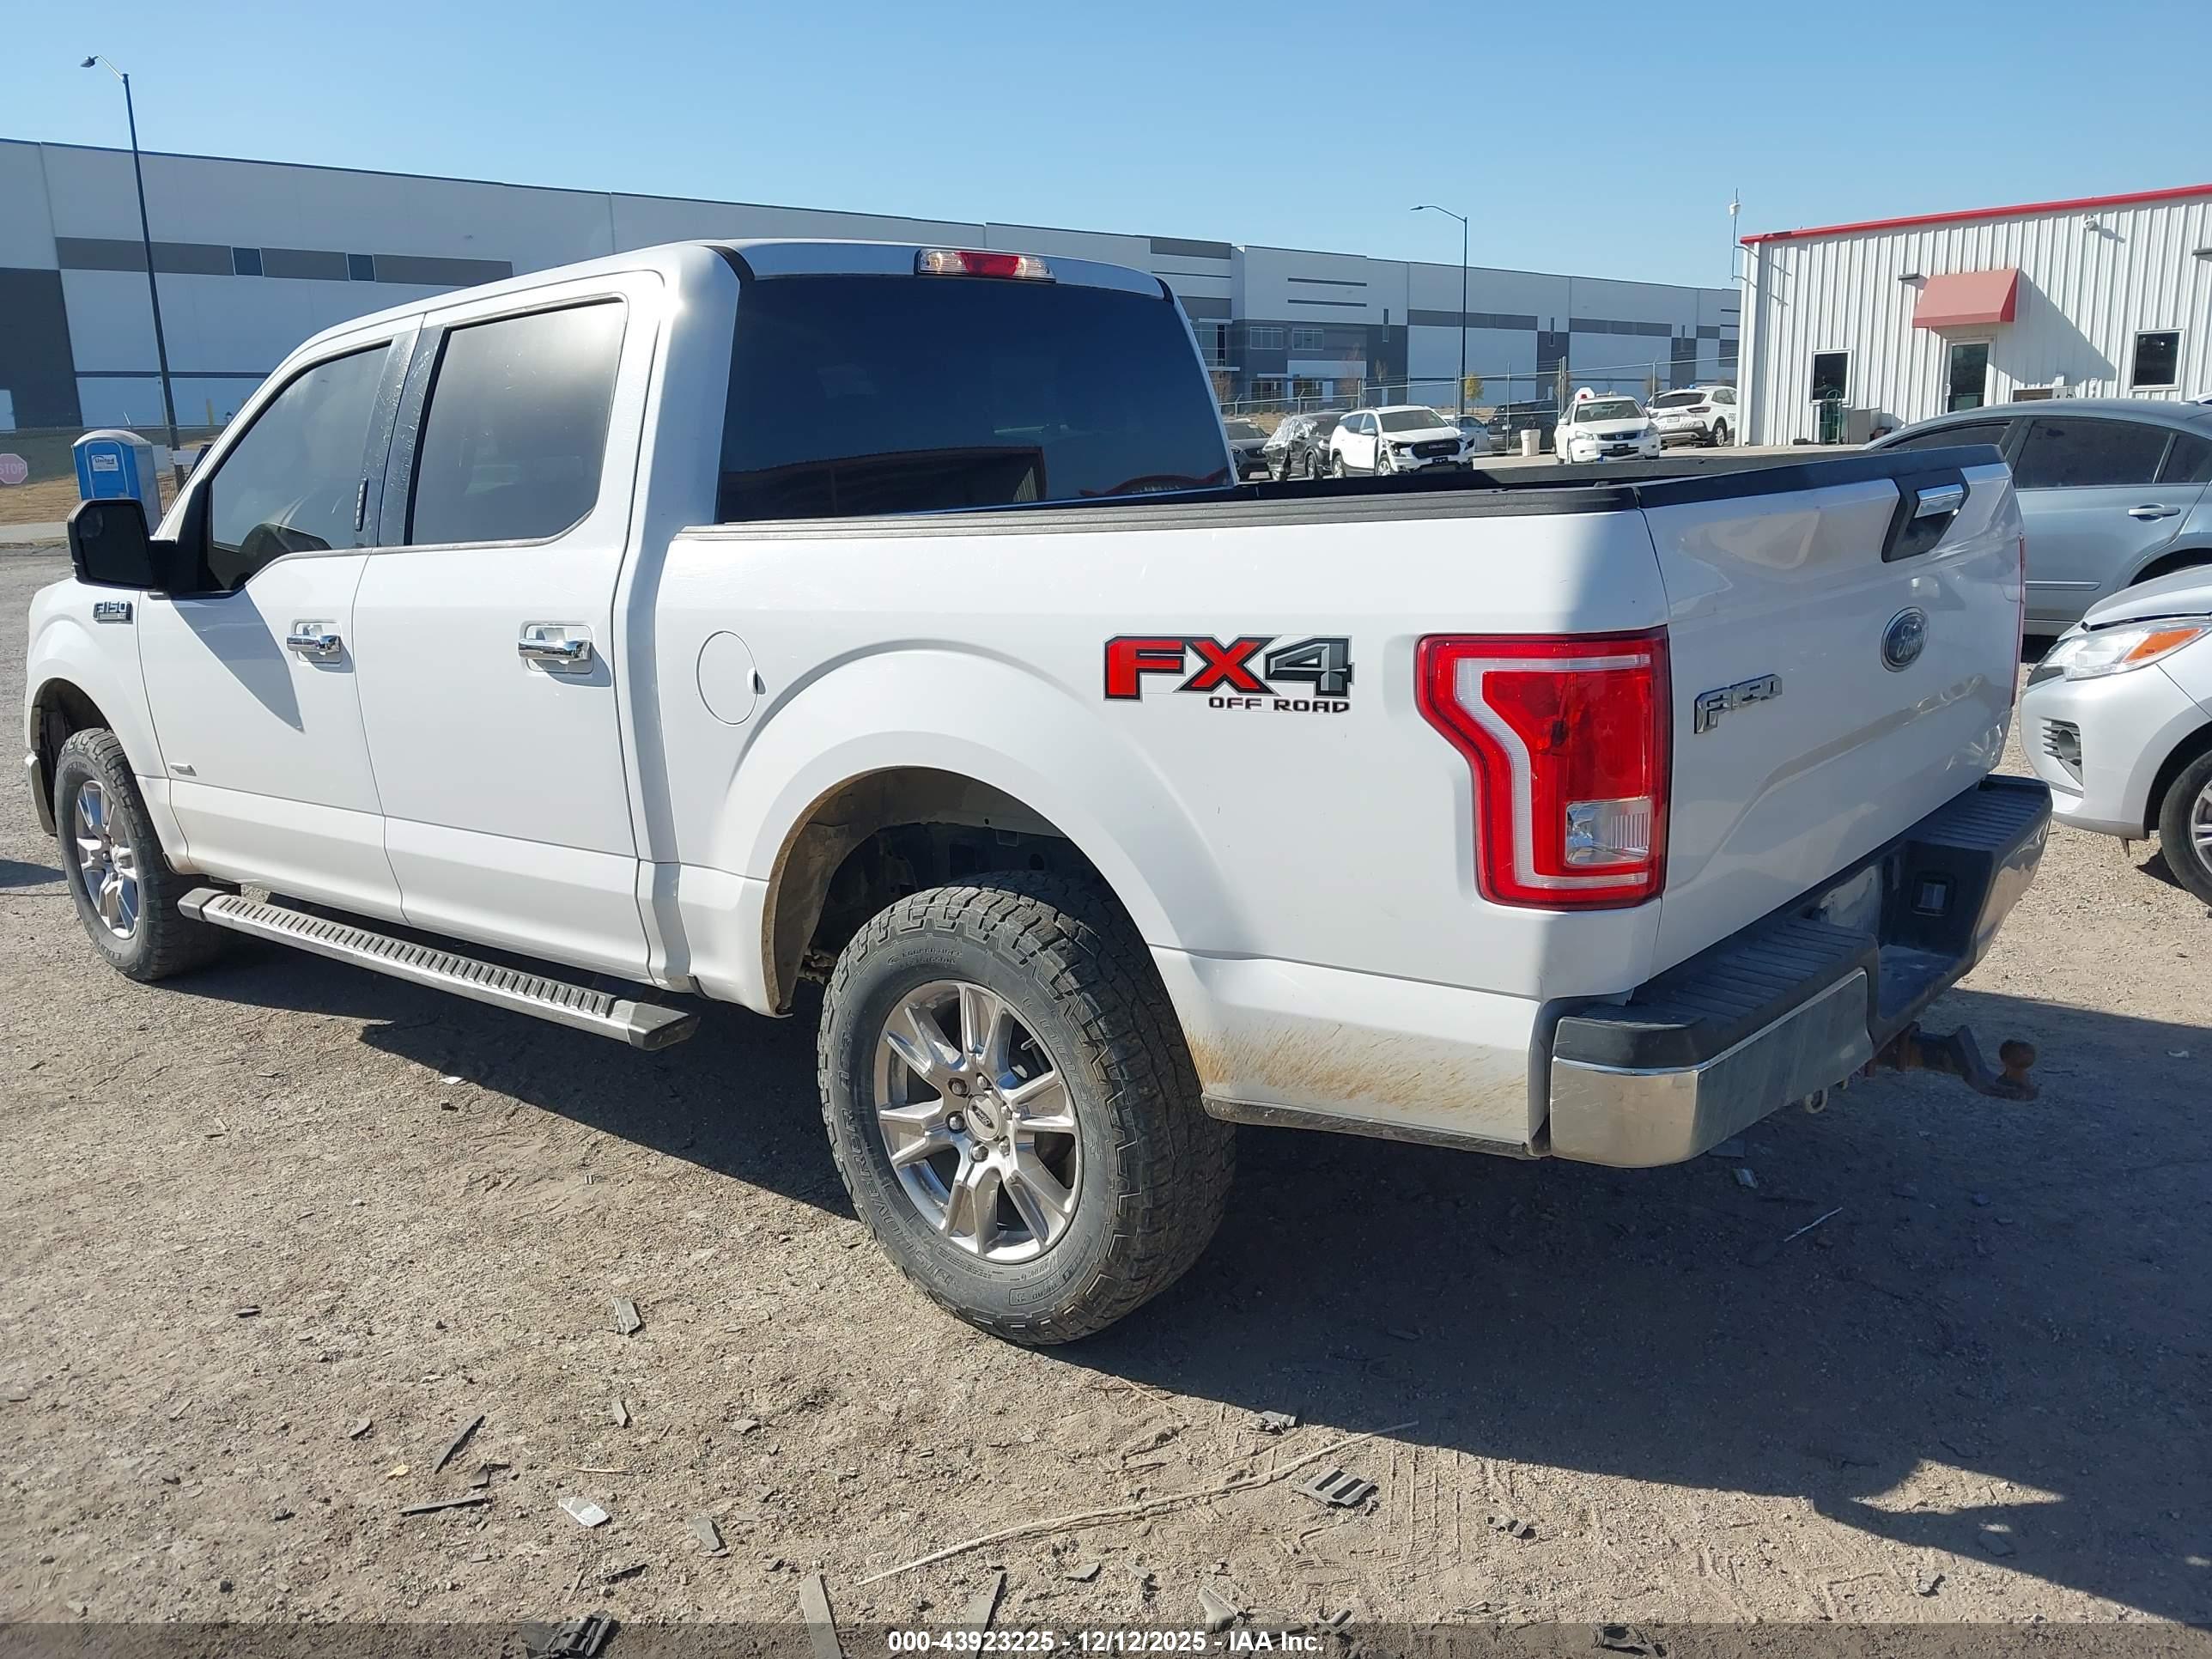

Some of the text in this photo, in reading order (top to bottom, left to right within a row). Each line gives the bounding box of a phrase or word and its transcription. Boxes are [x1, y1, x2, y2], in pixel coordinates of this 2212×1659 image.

[0, 463, 24, 475] STOP
[1103, 634, 1354, 702] FX4
[1209, 696, 1350, 714] OFF ROAD
